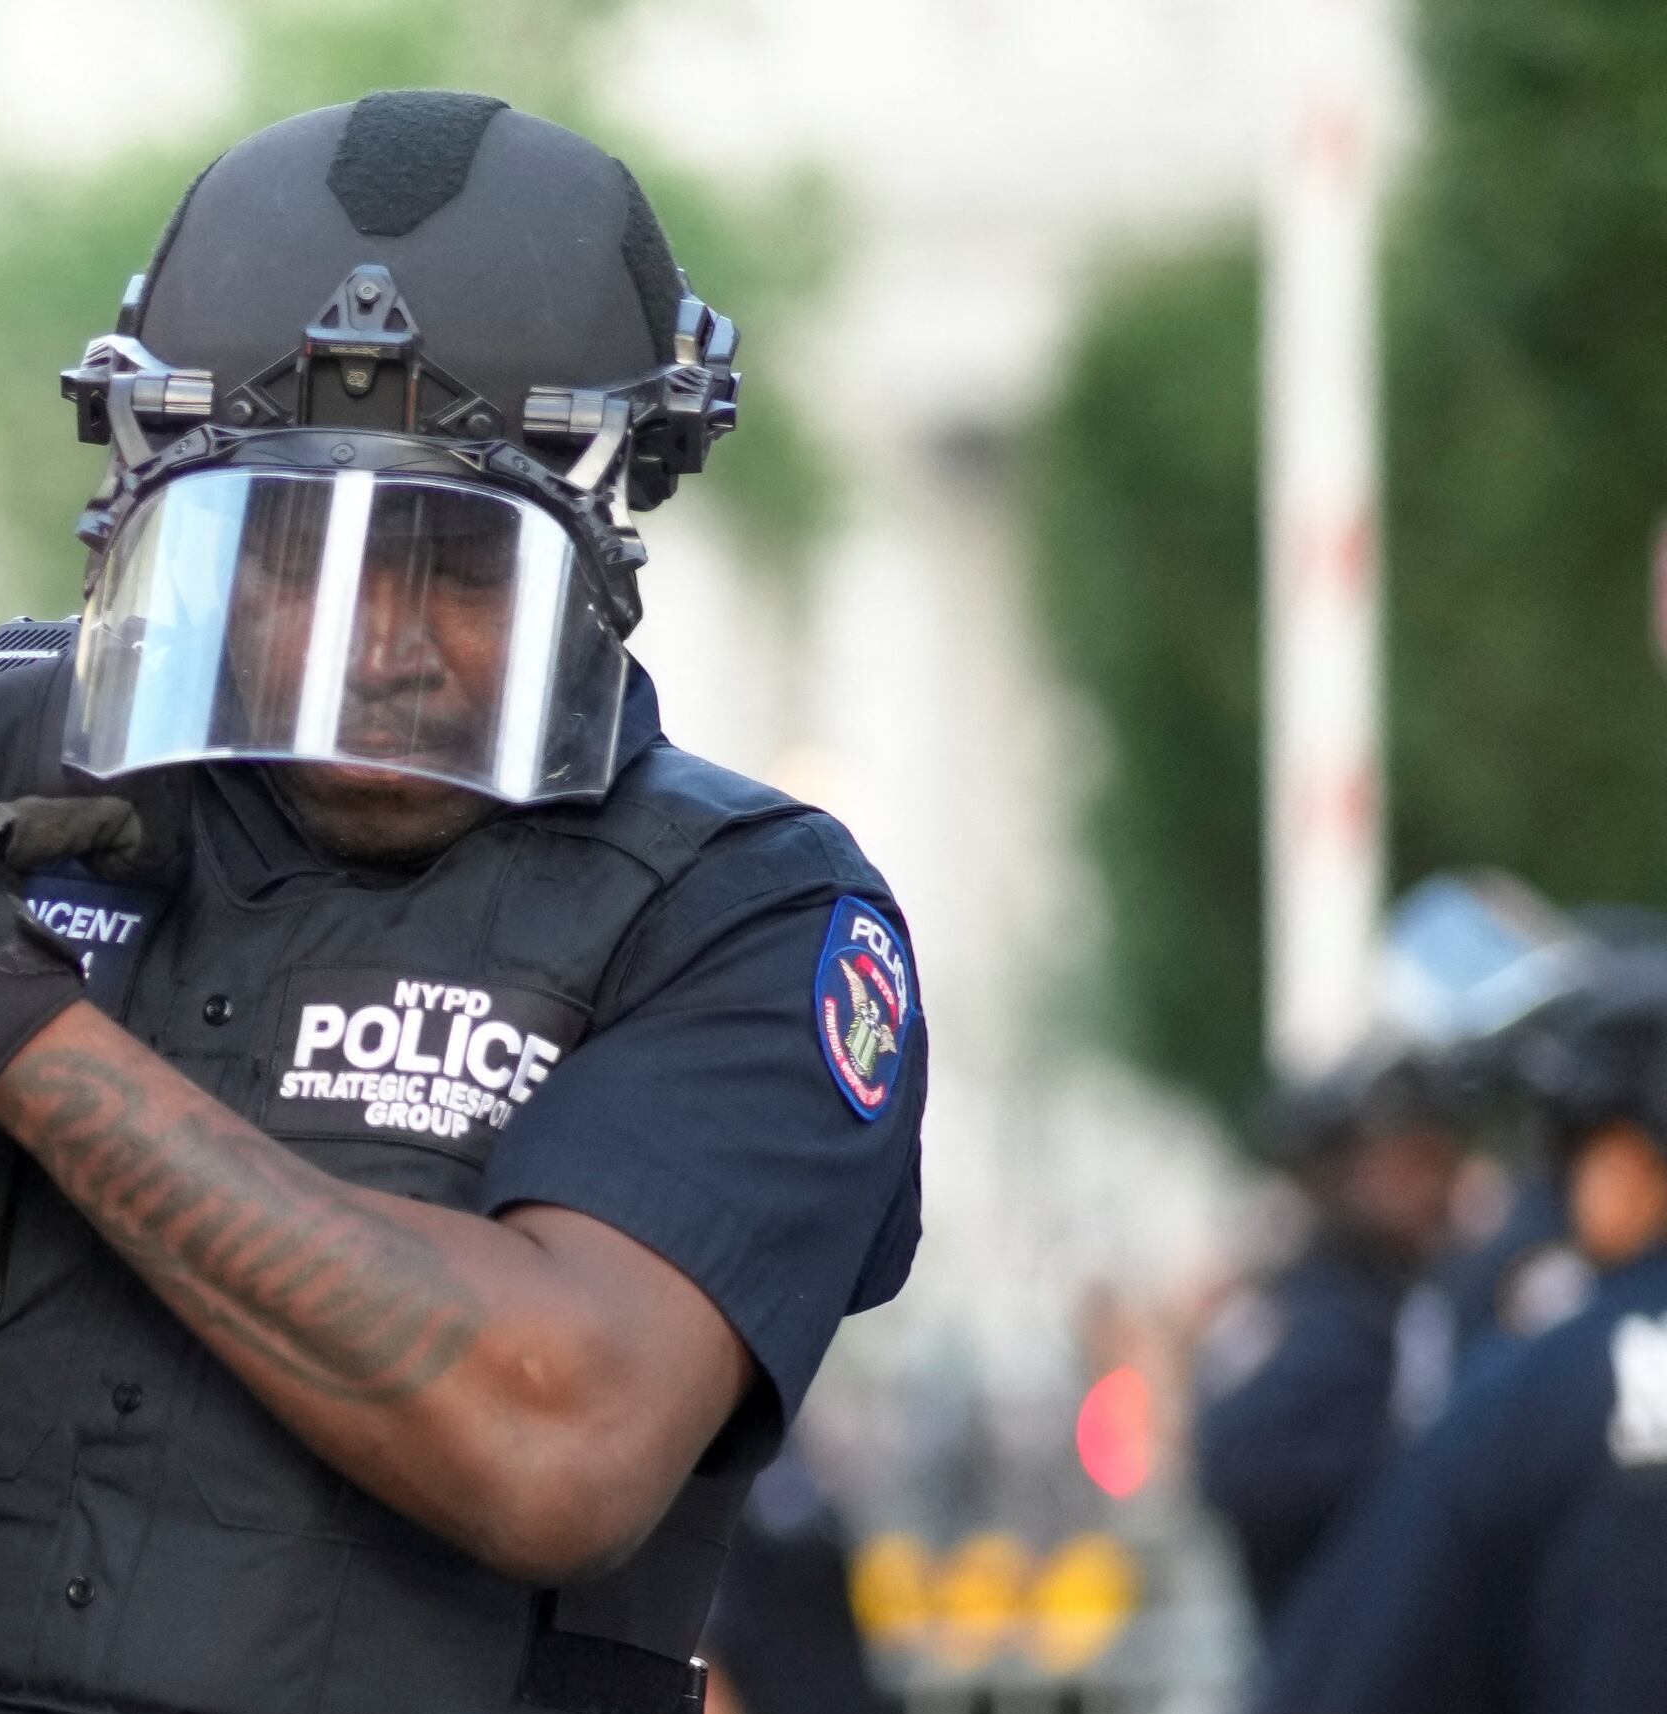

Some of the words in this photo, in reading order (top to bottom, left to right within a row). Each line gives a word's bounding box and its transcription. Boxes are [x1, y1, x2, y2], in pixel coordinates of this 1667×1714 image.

[394, 979, 492, 1018] NYPD
[293, 1003, 561, 1104] POLICE
[279, 1070, 427, 1103] STRATEGIC
[365, 1102, 470, 1139] GROUP
